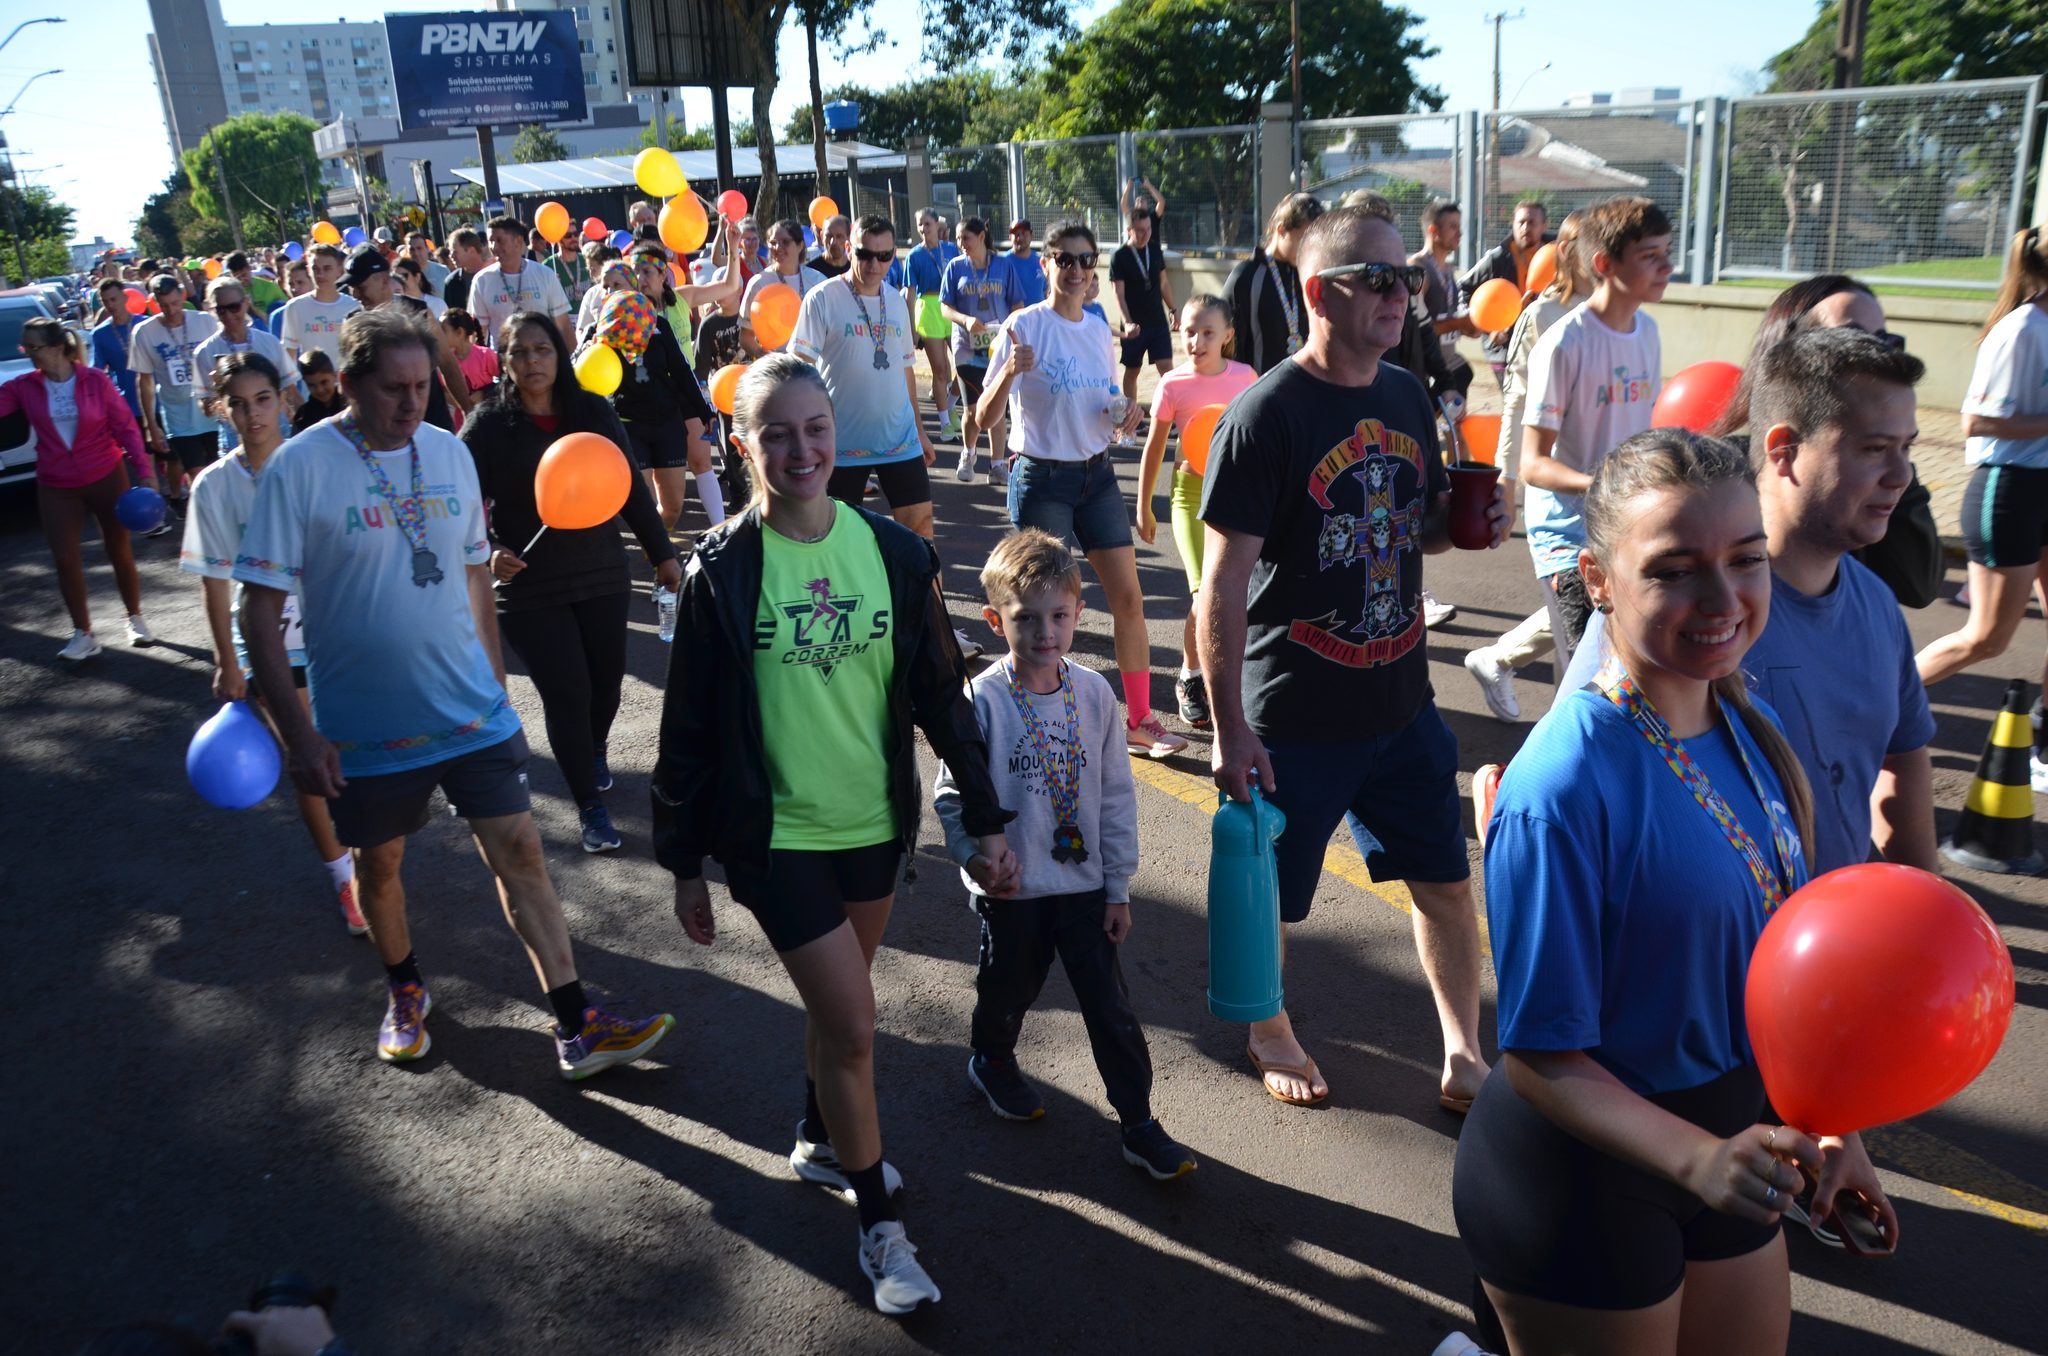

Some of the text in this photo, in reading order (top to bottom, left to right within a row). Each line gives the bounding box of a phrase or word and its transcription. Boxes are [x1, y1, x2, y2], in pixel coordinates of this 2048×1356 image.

[421, 20, 548, 55] PBNEW
[454, 53, 552, 68] SISTEMAS
[447, 74, 533, 88] Soluções tecnológicas
[462, 85, 496, 95] produtos
[781, 642, 870, 664] CORREM
[1052, 720, 1066, 730] ALL
